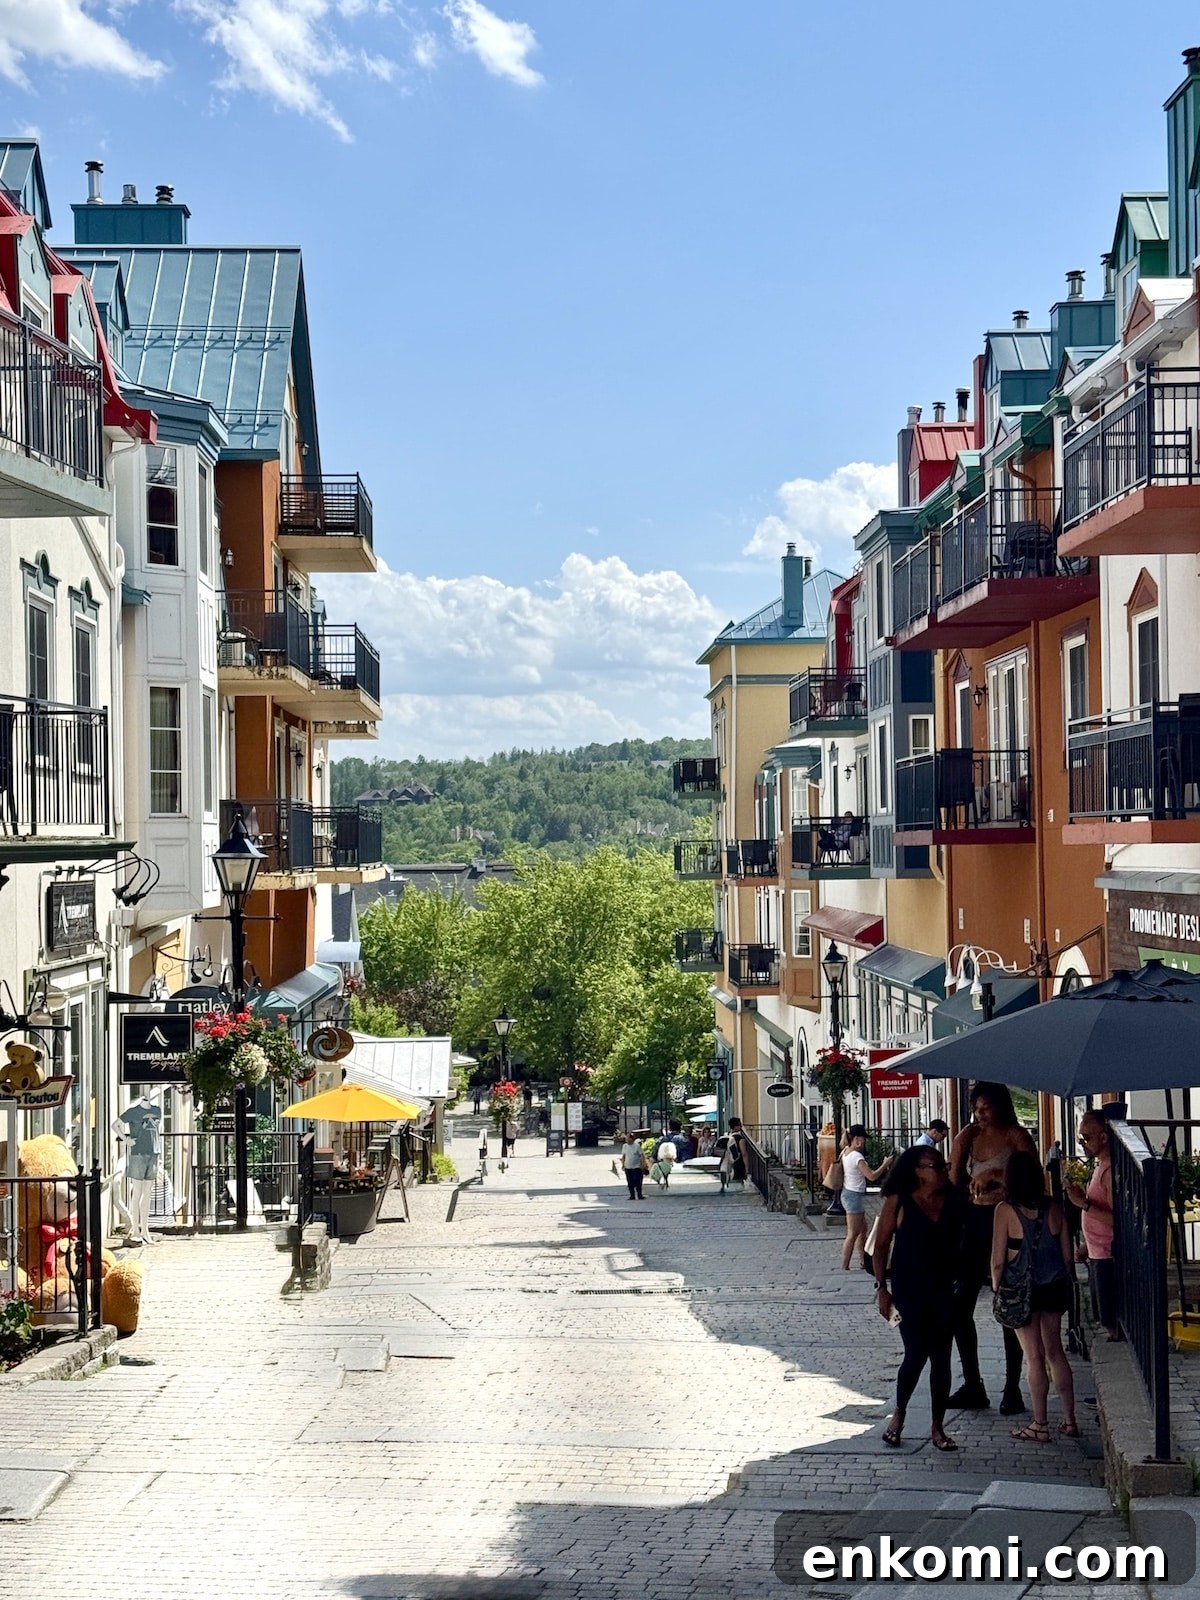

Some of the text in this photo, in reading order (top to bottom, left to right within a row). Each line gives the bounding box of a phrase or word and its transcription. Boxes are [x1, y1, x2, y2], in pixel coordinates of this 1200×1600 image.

[1129, 908, 1178, 938] PROMENADE
[178, 998, 230, 1017] Hatley
[126, 1052, 188, 1061] TREMBLANT
[877, 1079, 913, 1087] TREMBLANT
[21, 1092, 60, 1104] Toutou
